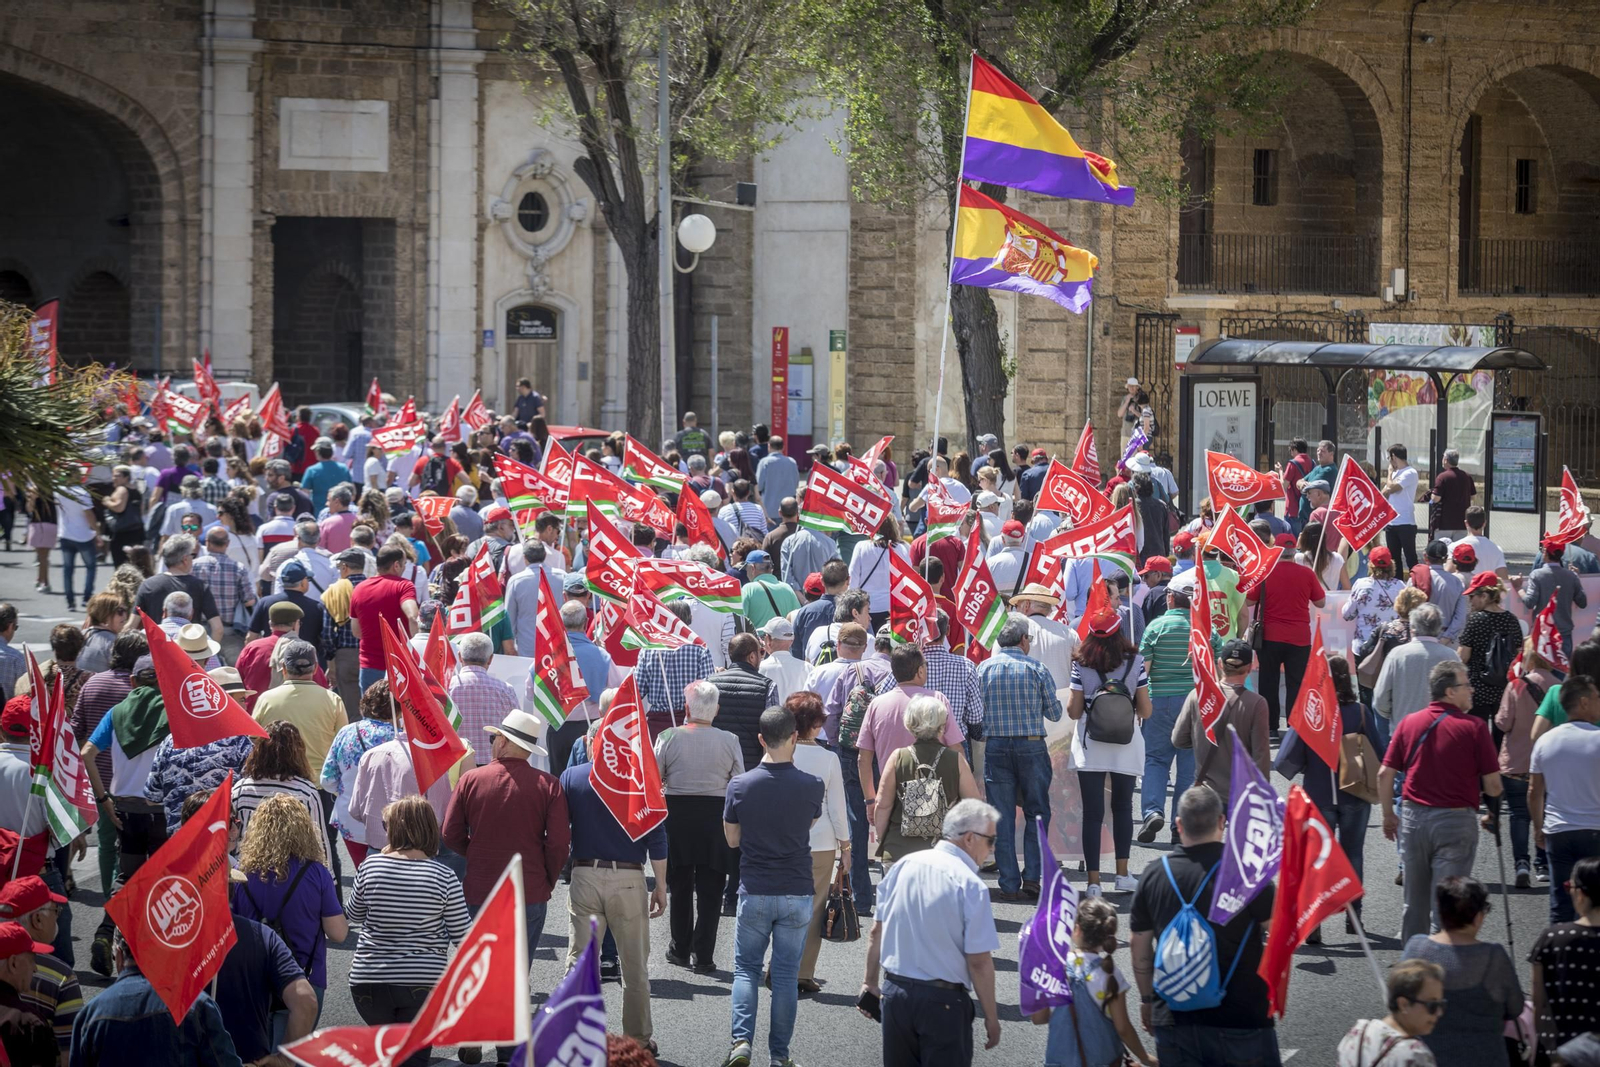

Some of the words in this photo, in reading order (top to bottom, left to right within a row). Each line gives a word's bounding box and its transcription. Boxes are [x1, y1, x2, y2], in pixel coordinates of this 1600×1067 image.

[1199, 389, 1251, 408] LOEWE
[809, 470, 885, 527] CCOO
[1354, 510, 1388, 541] www.ugt.es
[186, 678, 212, 713] UGT
[402, 698, 438, 738] Andalucía
[150, 880, 191, 930] UGT
